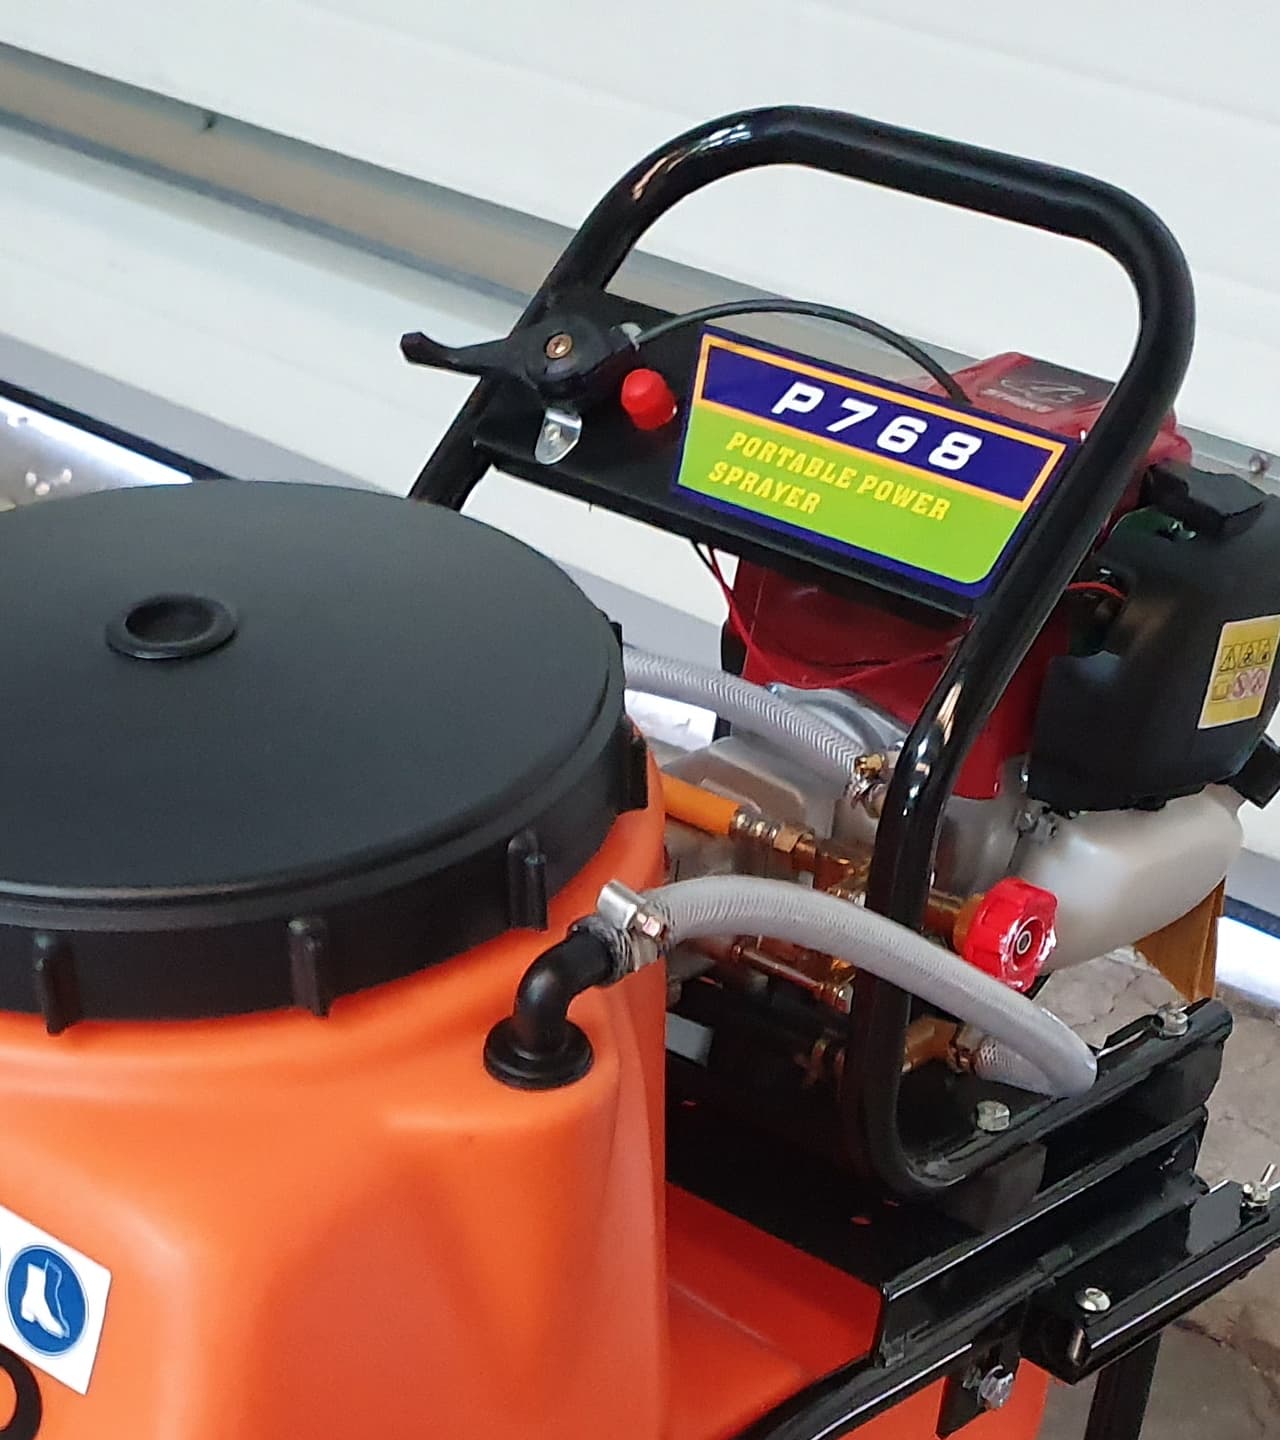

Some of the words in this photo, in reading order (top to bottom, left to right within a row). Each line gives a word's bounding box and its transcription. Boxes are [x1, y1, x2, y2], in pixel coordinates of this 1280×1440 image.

[771, 381, 983, 471] P768
[709, 462, 821, 514] SPRAYER
[726, 432, 857, 489] PORTABLE
[857, 475, 951, 520] POWER
